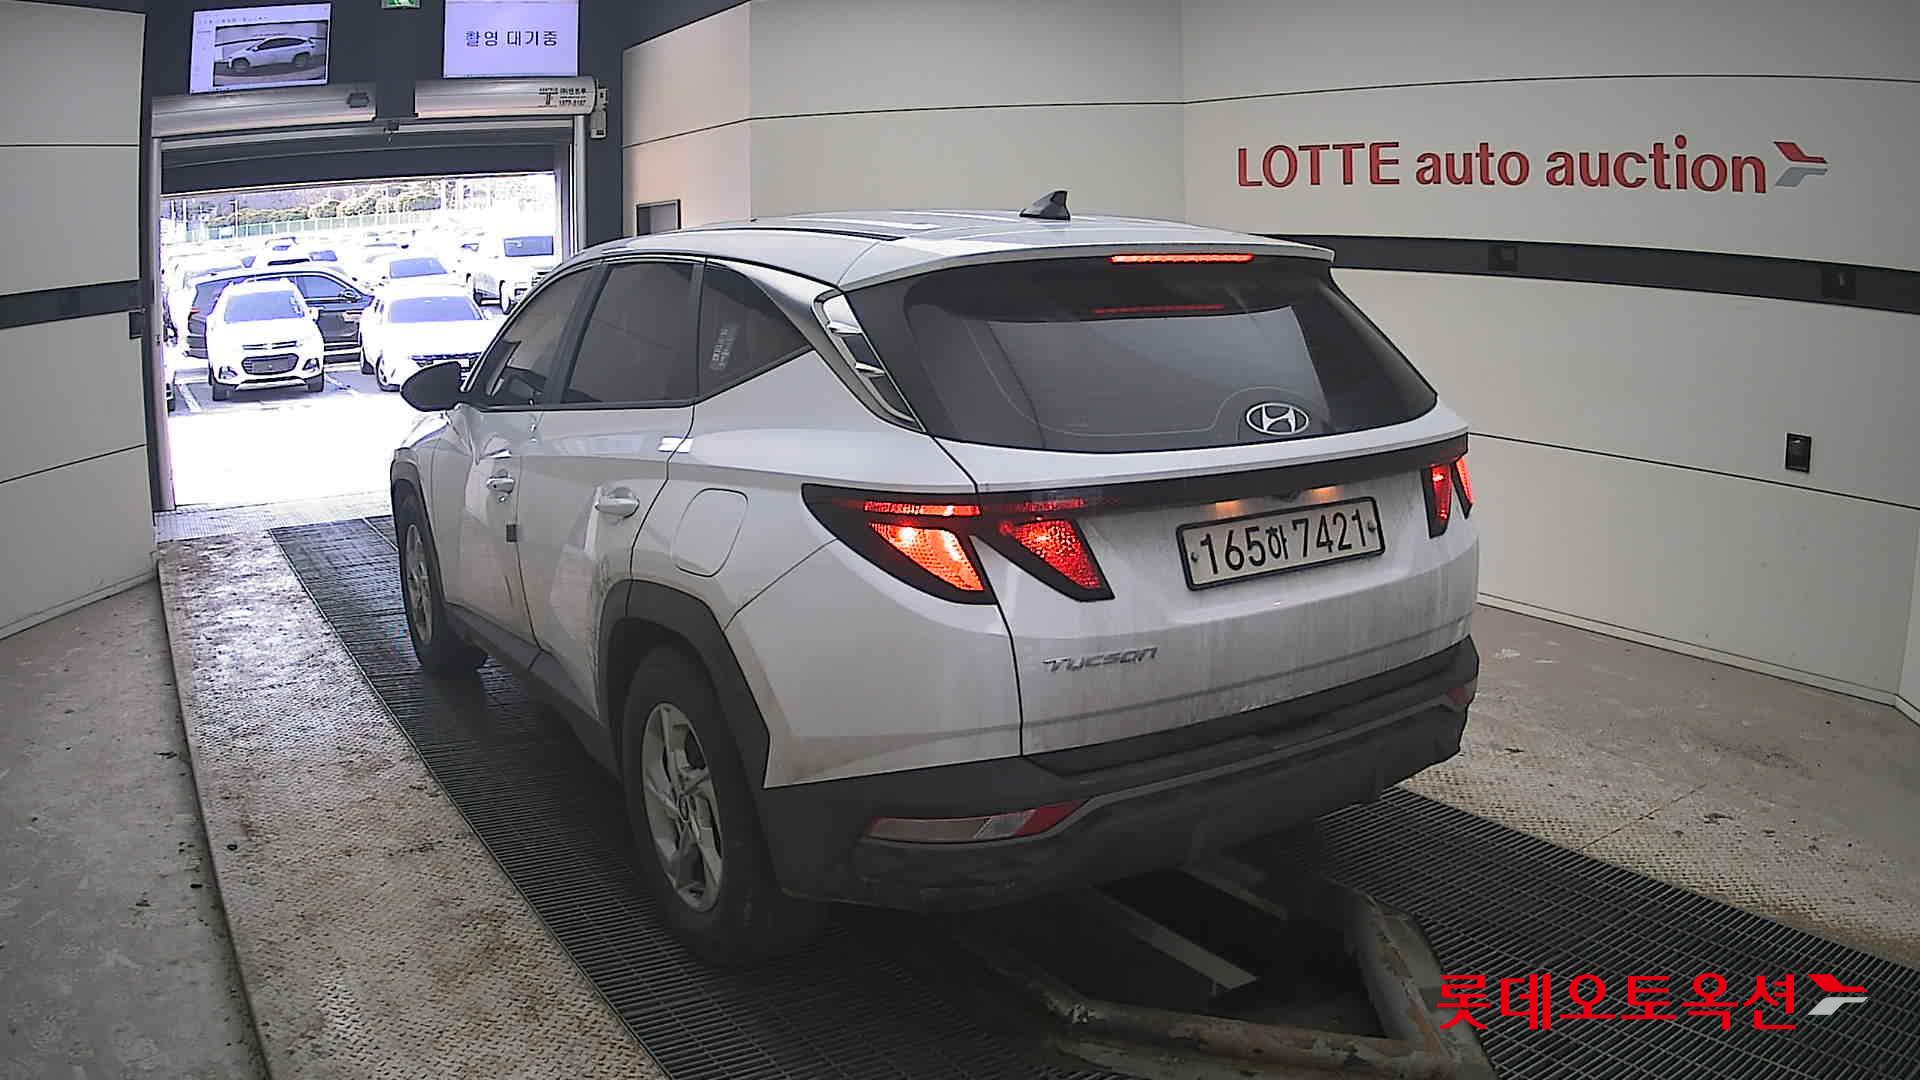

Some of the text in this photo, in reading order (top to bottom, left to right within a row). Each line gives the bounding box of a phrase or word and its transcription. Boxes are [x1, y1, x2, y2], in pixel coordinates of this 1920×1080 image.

[465, 30, 558, 47] 촬영 대기중
[1237, 134, 1767, 194] LOTTE auto auction
